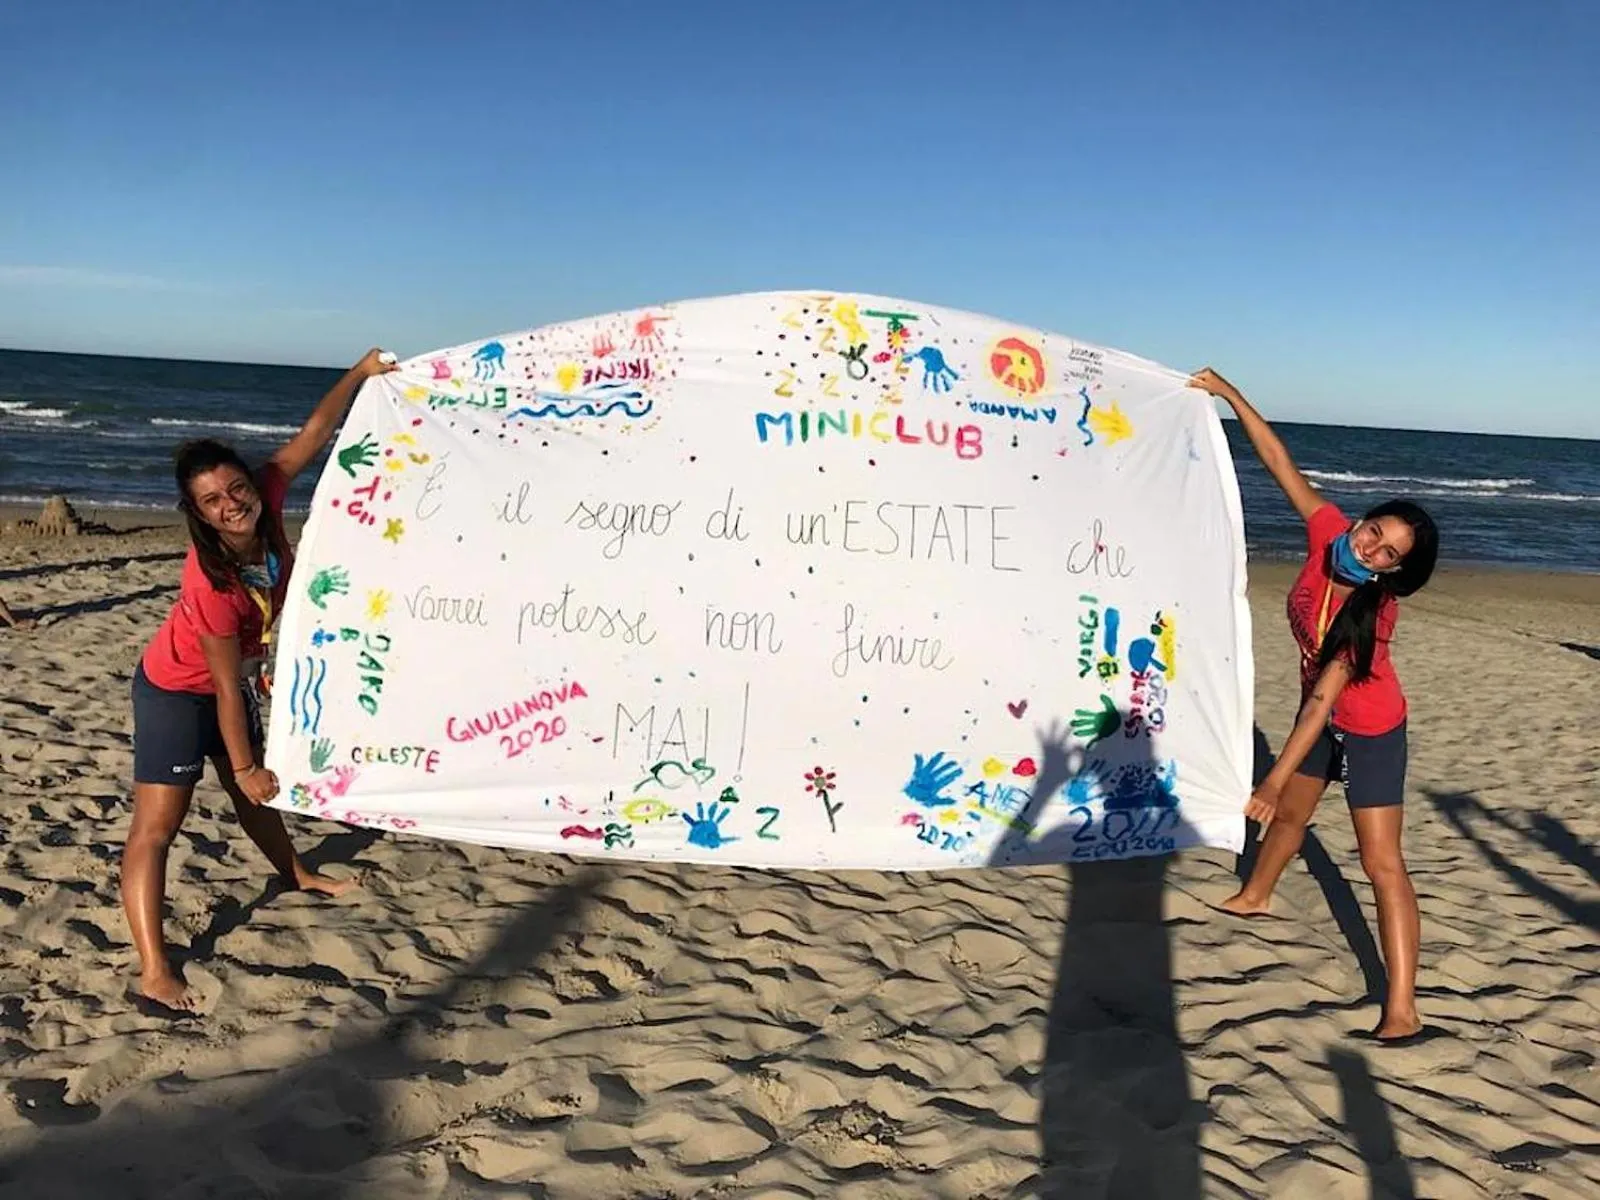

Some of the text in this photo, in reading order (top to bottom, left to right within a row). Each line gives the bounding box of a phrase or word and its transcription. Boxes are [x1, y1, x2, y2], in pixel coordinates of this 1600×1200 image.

[755, 407, 984, 461] MINICLUB
[968, 400, 1058, 425] AMANDA
[498, 481, 533, 525] il
[564, 498, 682, 560] segno
[705, 487, 750, 543] di
[1067, 518, 1136, 578] che
[516, 583, 657, 645] potesse
[705, 607, 784, 655] non
[831, 603, 956, 678] finire
[445, 680, 588, 743] GIULIANOVA
[499, 715, 567, 759] 2020
[351, 745, 441, 774] CELESTE
